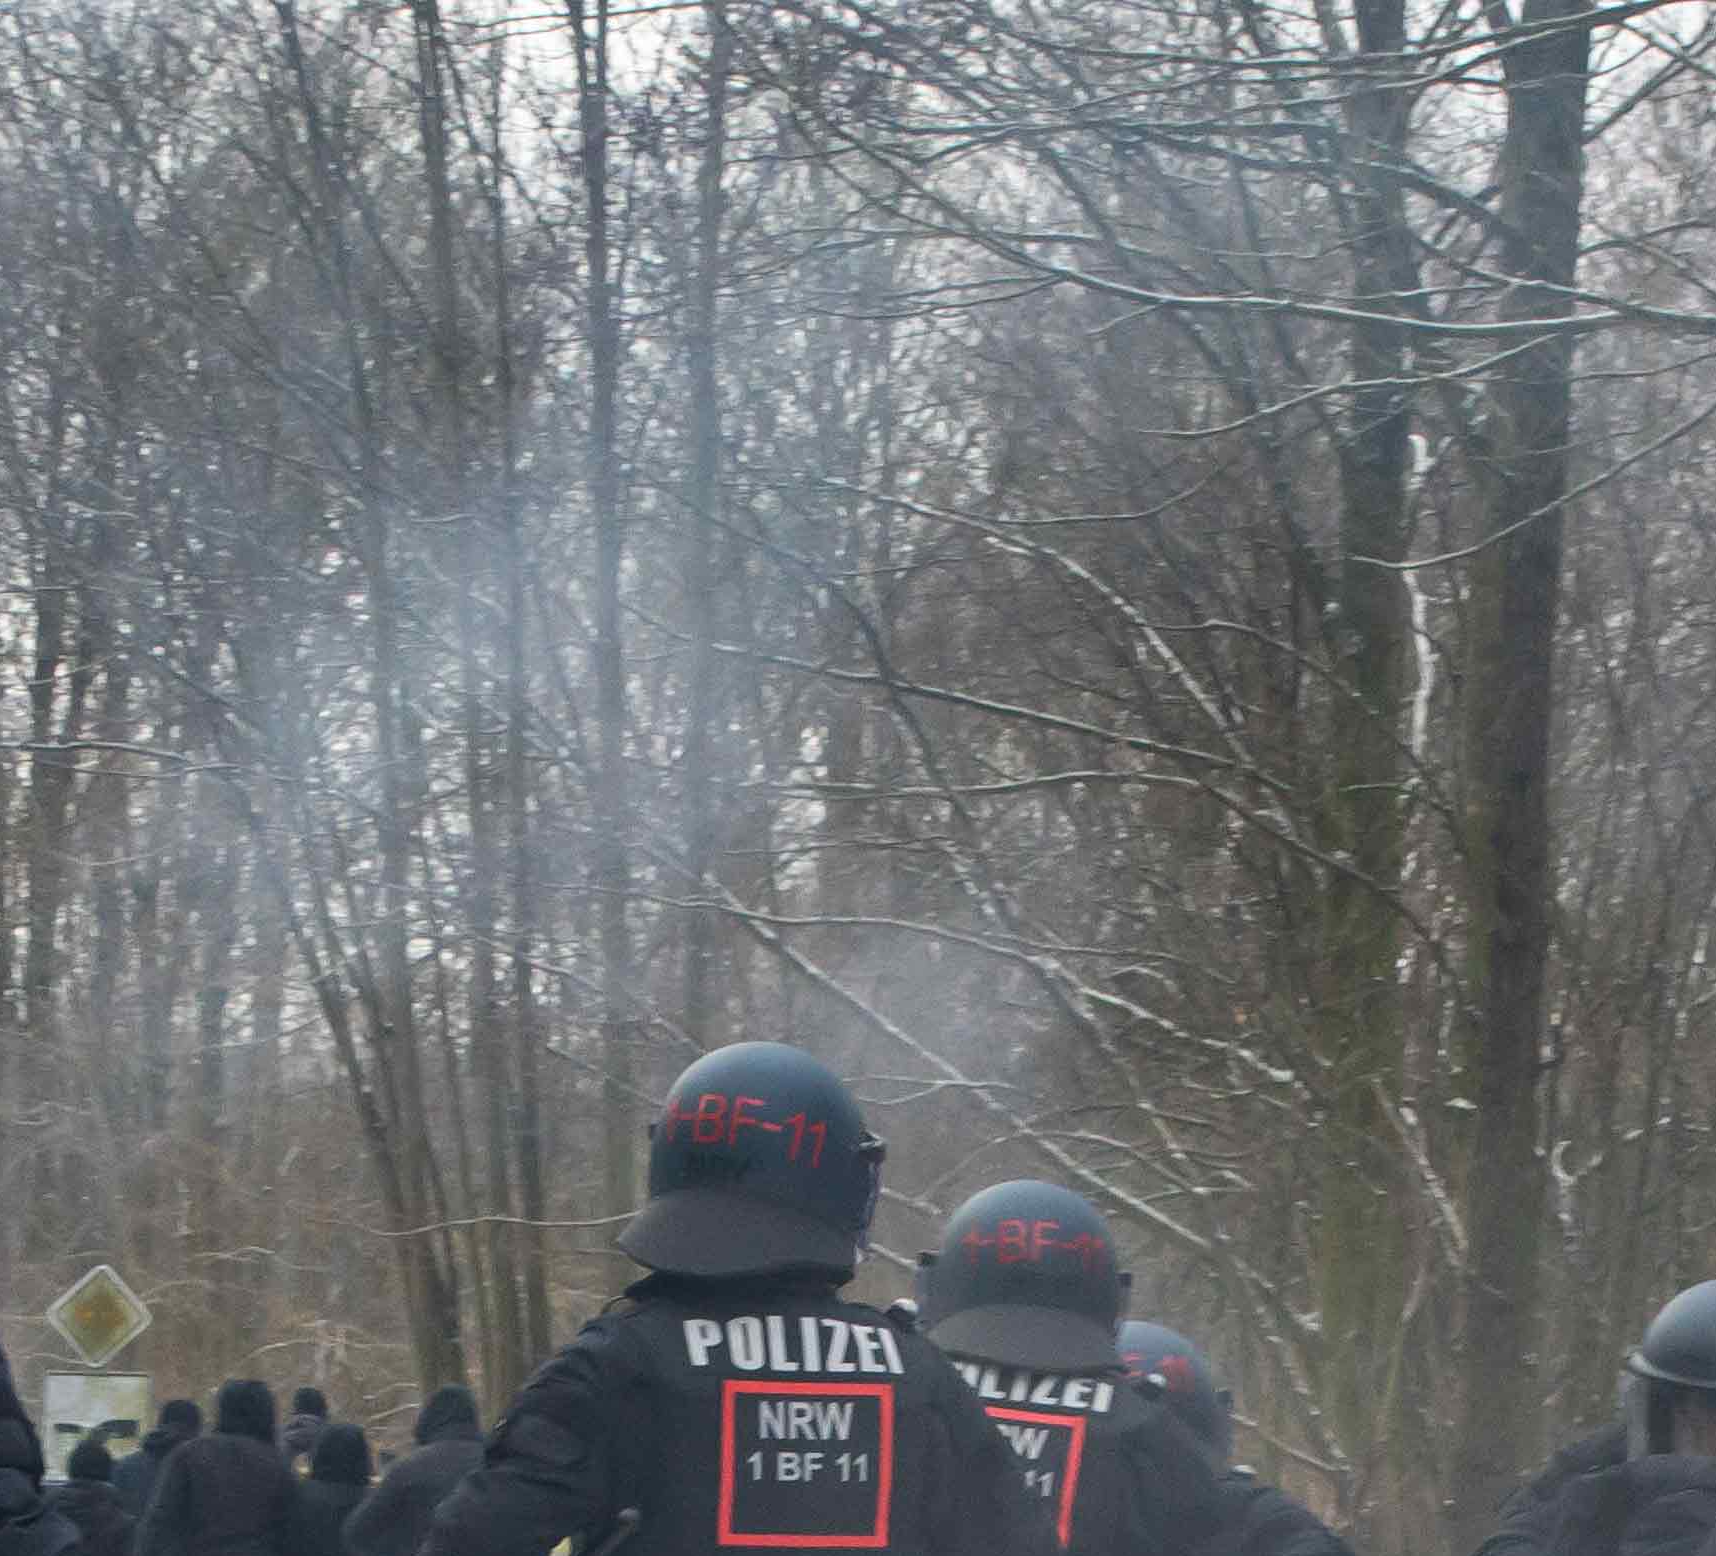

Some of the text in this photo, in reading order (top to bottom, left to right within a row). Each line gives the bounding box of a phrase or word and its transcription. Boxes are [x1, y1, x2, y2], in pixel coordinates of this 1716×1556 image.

[683, 1316, 905, 1375] POLIZEI
[757, 1401, 853, 1441] NRW
[747, 1453, 869, 1483] 1 BF 11
